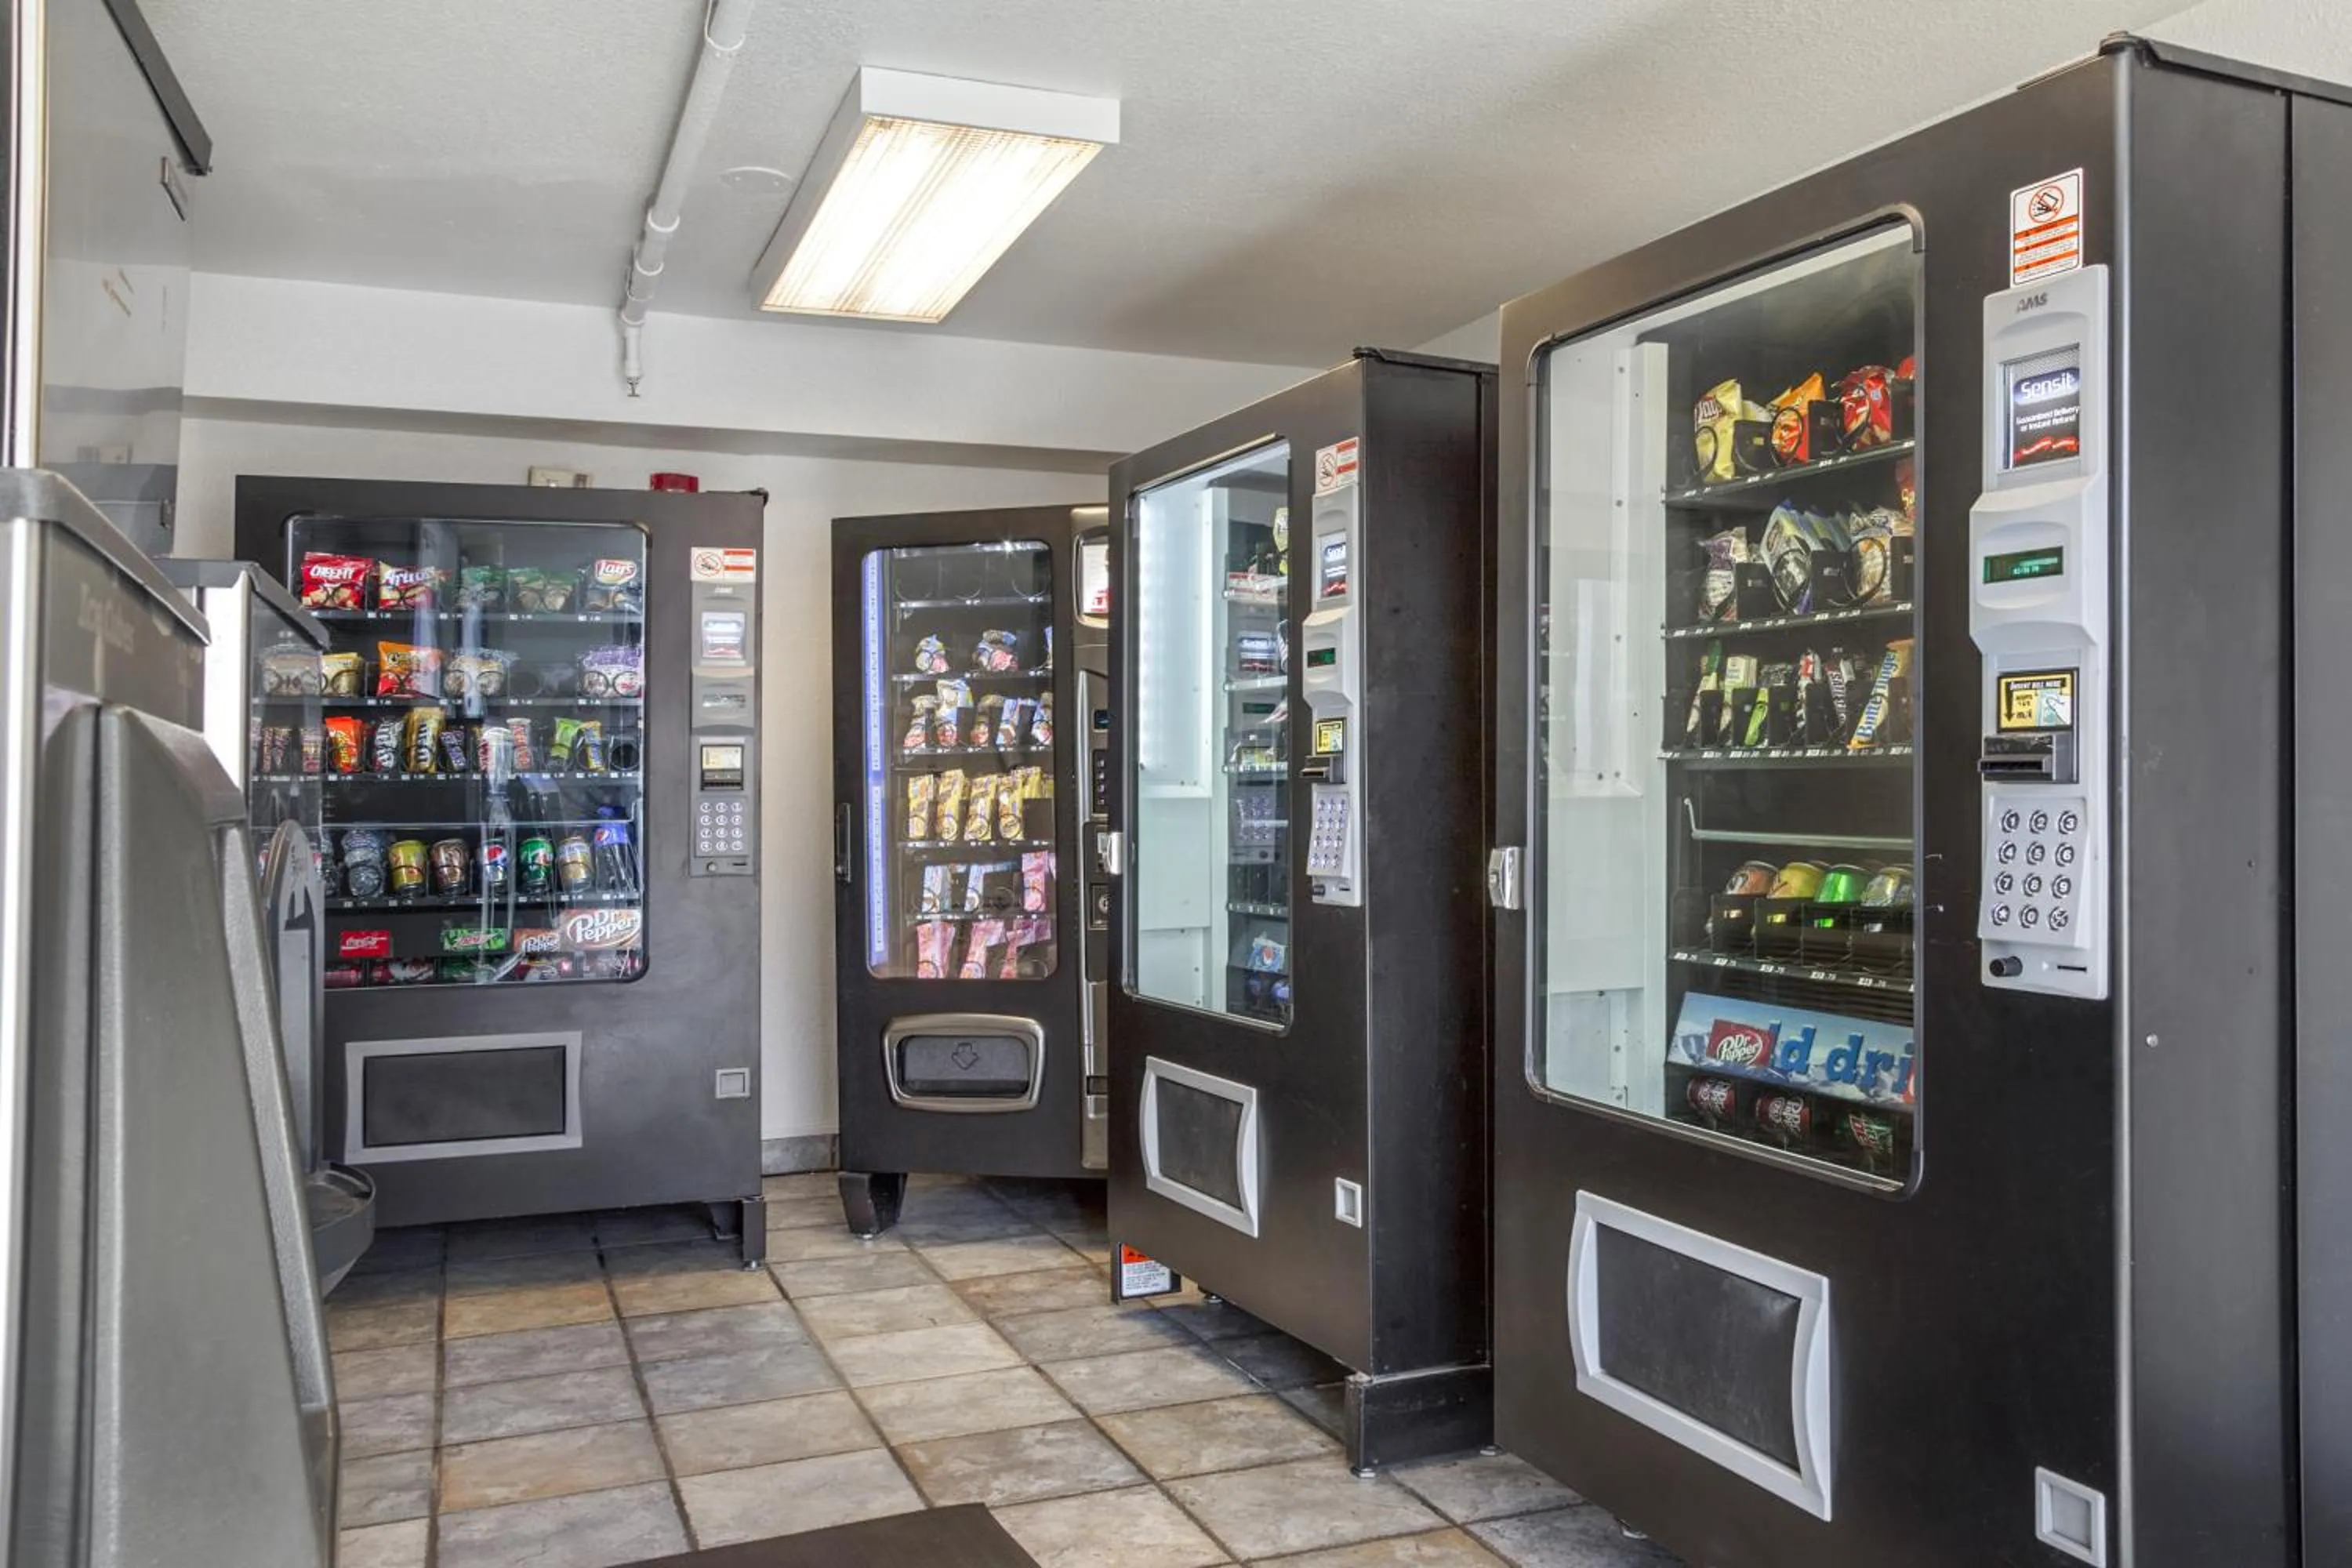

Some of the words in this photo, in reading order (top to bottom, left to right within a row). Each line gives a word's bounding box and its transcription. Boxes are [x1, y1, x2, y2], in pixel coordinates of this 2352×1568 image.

[2020, 372, 2075, 399] Sensit
[575, 913, 637, 944] Pepper
[593, 909, 615, 926] Dr
[1721, 1036, 1759, 1062] Pepper
[1735, 1034, 1751, 1048] Dr
[1826, 1031, 1915, 1098] dri
